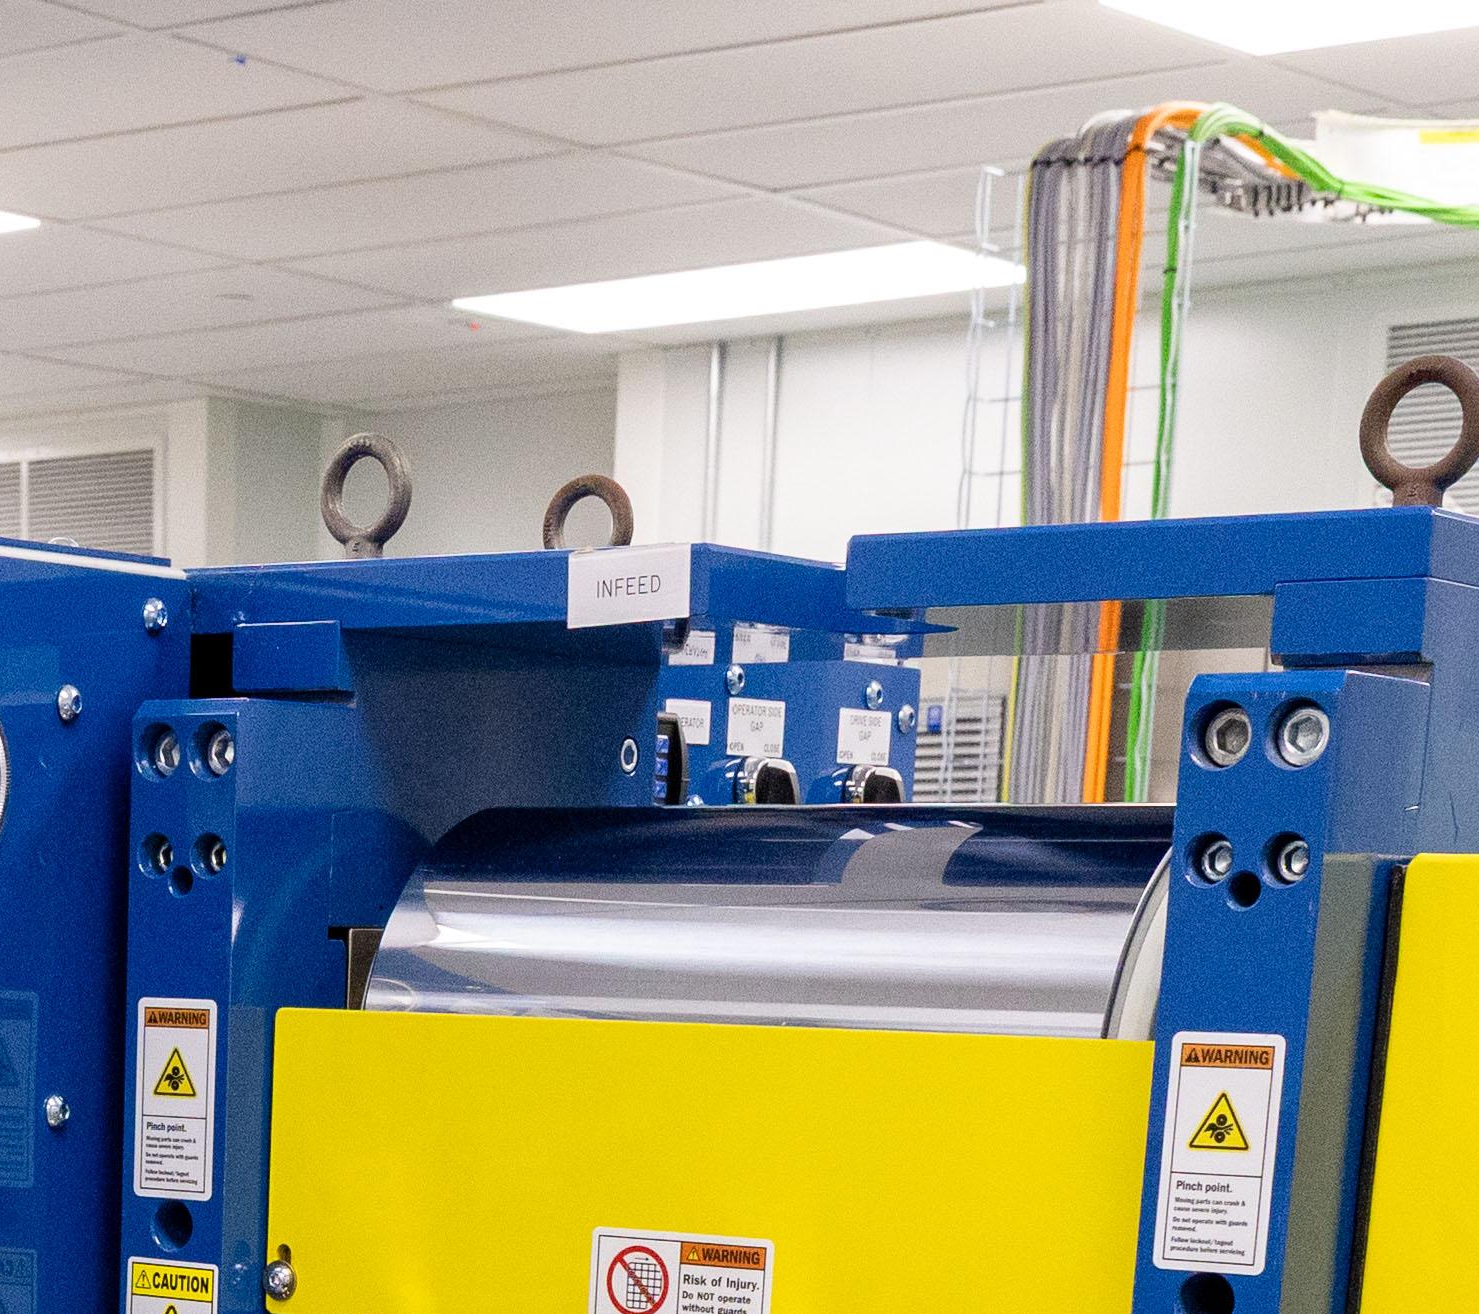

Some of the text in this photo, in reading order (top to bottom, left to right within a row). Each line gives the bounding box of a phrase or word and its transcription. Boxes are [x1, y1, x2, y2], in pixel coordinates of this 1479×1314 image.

[596, 575, 661, 598] INFEED
[158, 1011, 207, 1026] WARNING
[1201, 1048, 1269, 1066] WARNING
[146, 1121, 165, 1133] Pinch
[1176, 1180, 1232, 1194] Pinch point.
[702, 1247, 760, 1265] WARNING
[152, 1272, 210, 1293] CAUTION
[683, 1274, 760, 1292] Risk of Injury.
[682, 1291, 751, 1305] Do NOT operate
[682, 1304, 715, 1314] without
